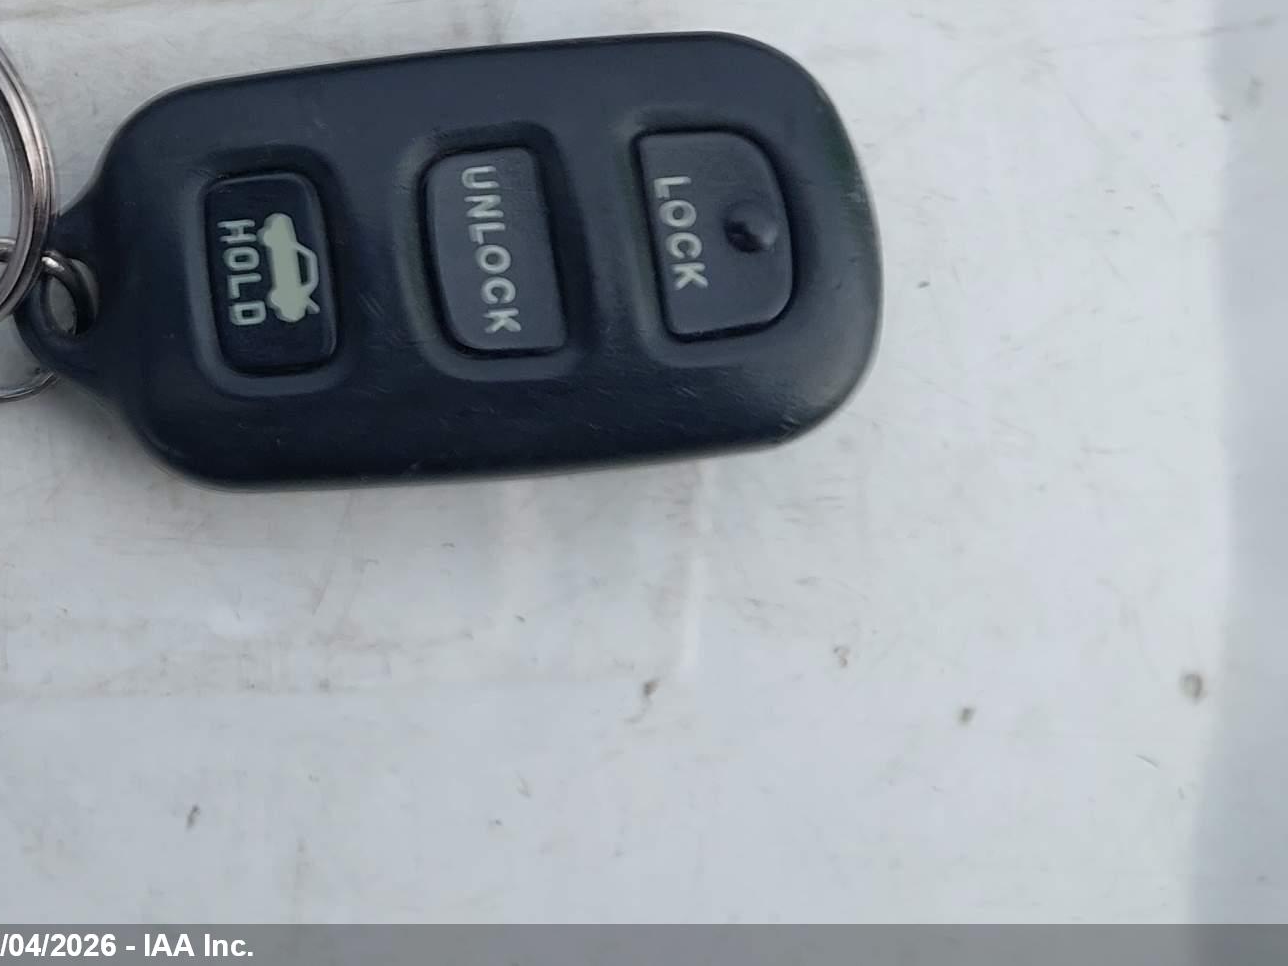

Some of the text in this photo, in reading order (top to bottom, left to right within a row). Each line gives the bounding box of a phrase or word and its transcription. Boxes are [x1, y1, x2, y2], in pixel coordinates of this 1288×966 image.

[218, 218, 267, 327] HOLD
[462, 165, 521, 334] UNLOCK
[654, 175, 708, 290] LOCK
